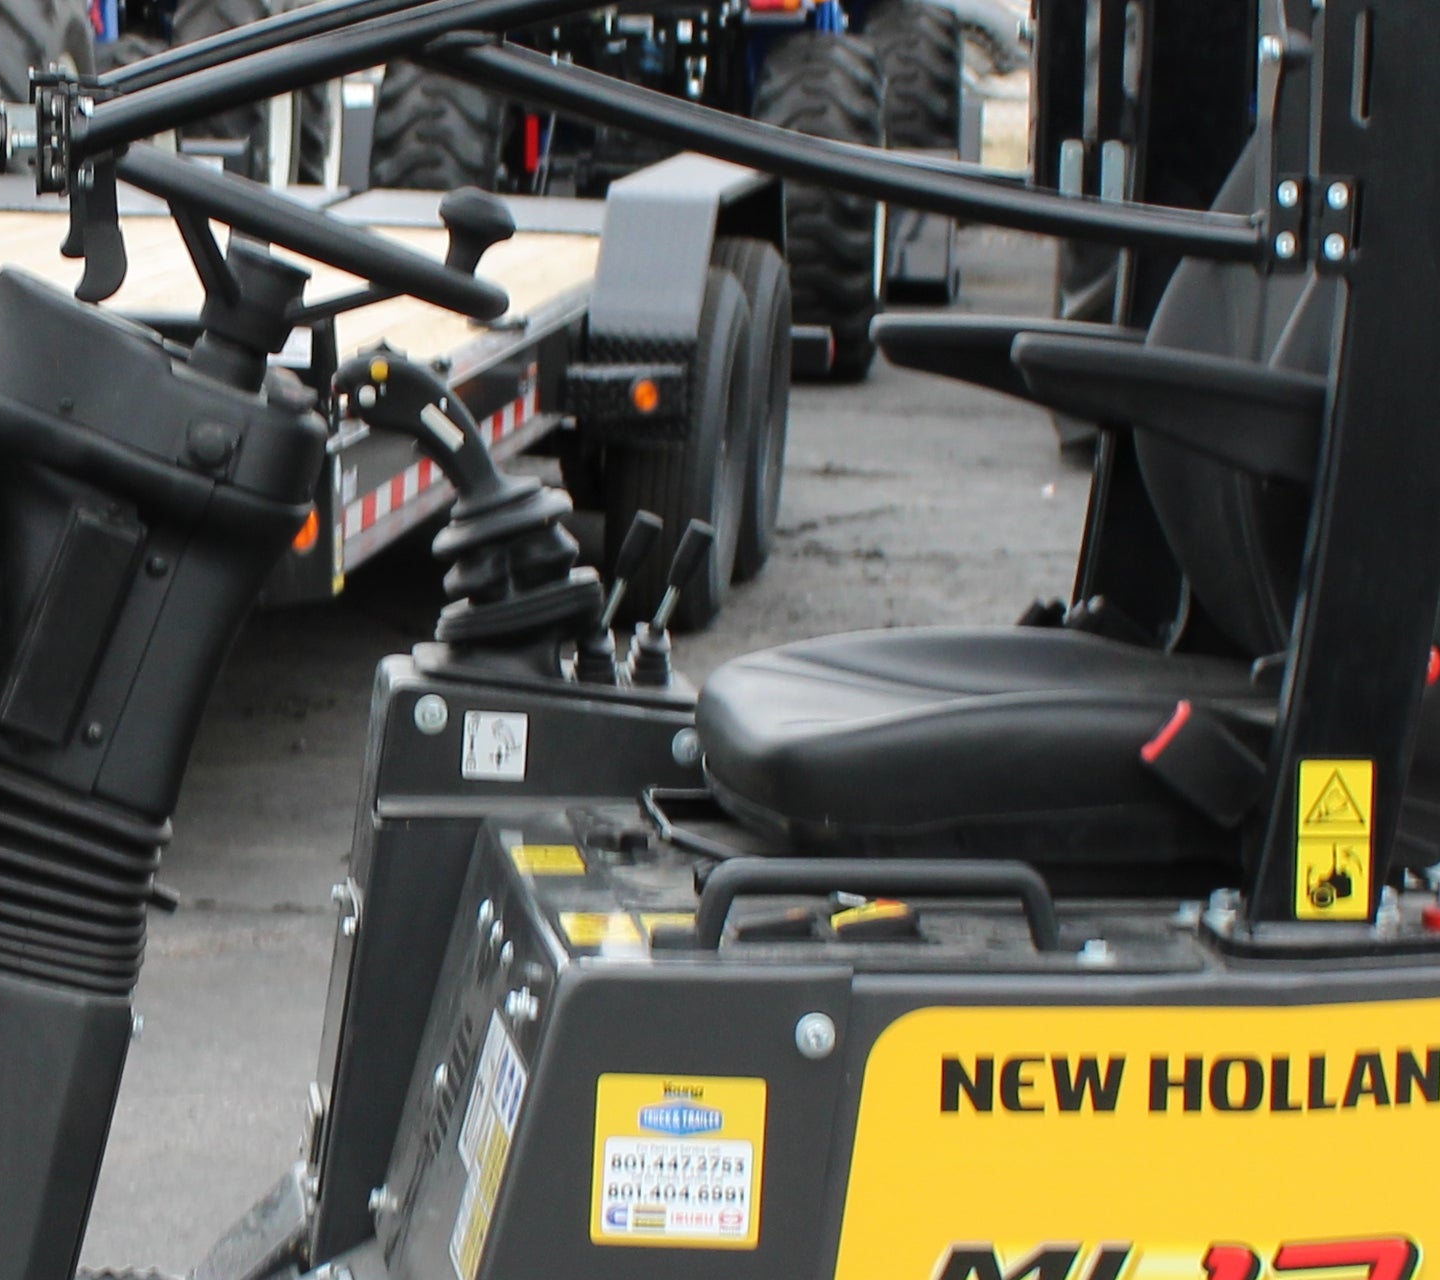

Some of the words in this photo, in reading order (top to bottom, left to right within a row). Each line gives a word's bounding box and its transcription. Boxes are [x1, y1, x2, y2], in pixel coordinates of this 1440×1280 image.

[938, 1051, 1126, 1116] NEW
[643, 1108, 671, 1126] TRUCK
[682, 1108, 720, 1128] TRAILER
